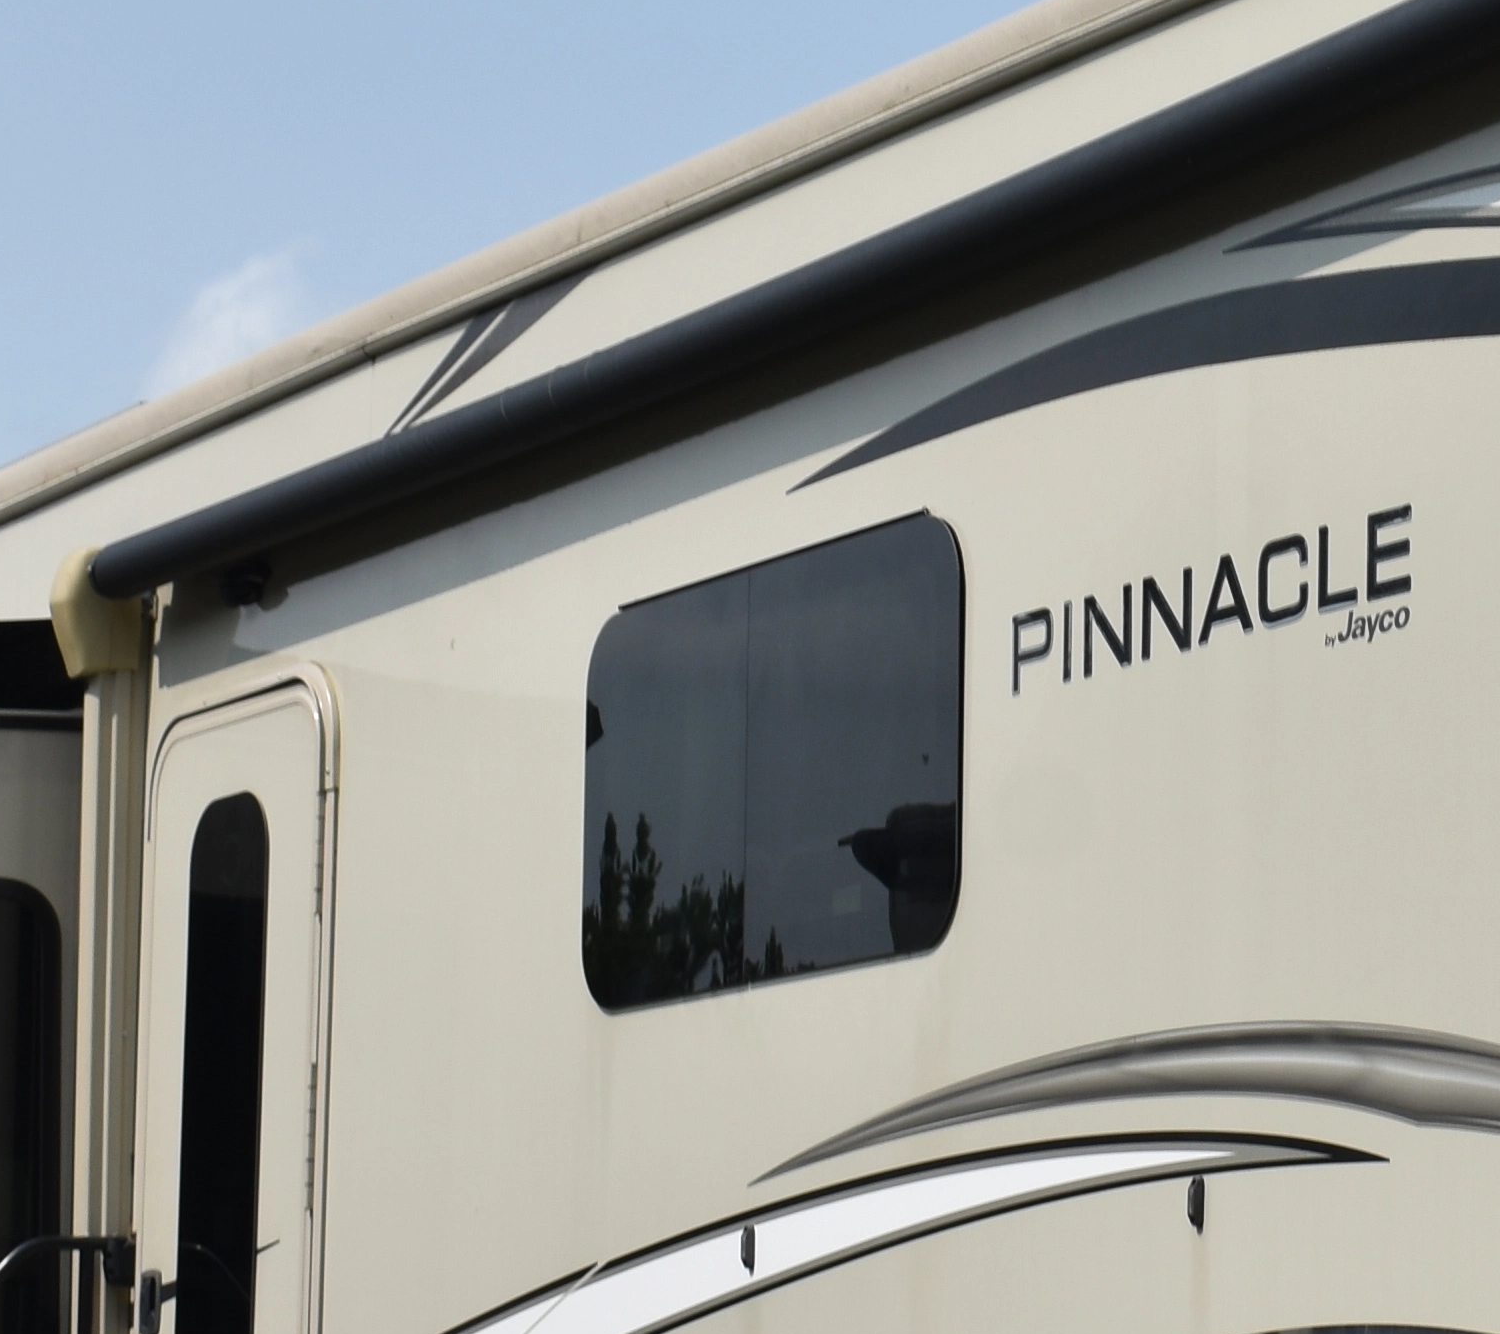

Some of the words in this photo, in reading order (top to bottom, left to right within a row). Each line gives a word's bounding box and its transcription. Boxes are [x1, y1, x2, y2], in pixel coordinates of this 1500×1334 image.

[1011, 501, 1413, 697] PINNACLE
[1324, 633, 1336, 648] by
[1338, 605, 1411, 644] Jayco
